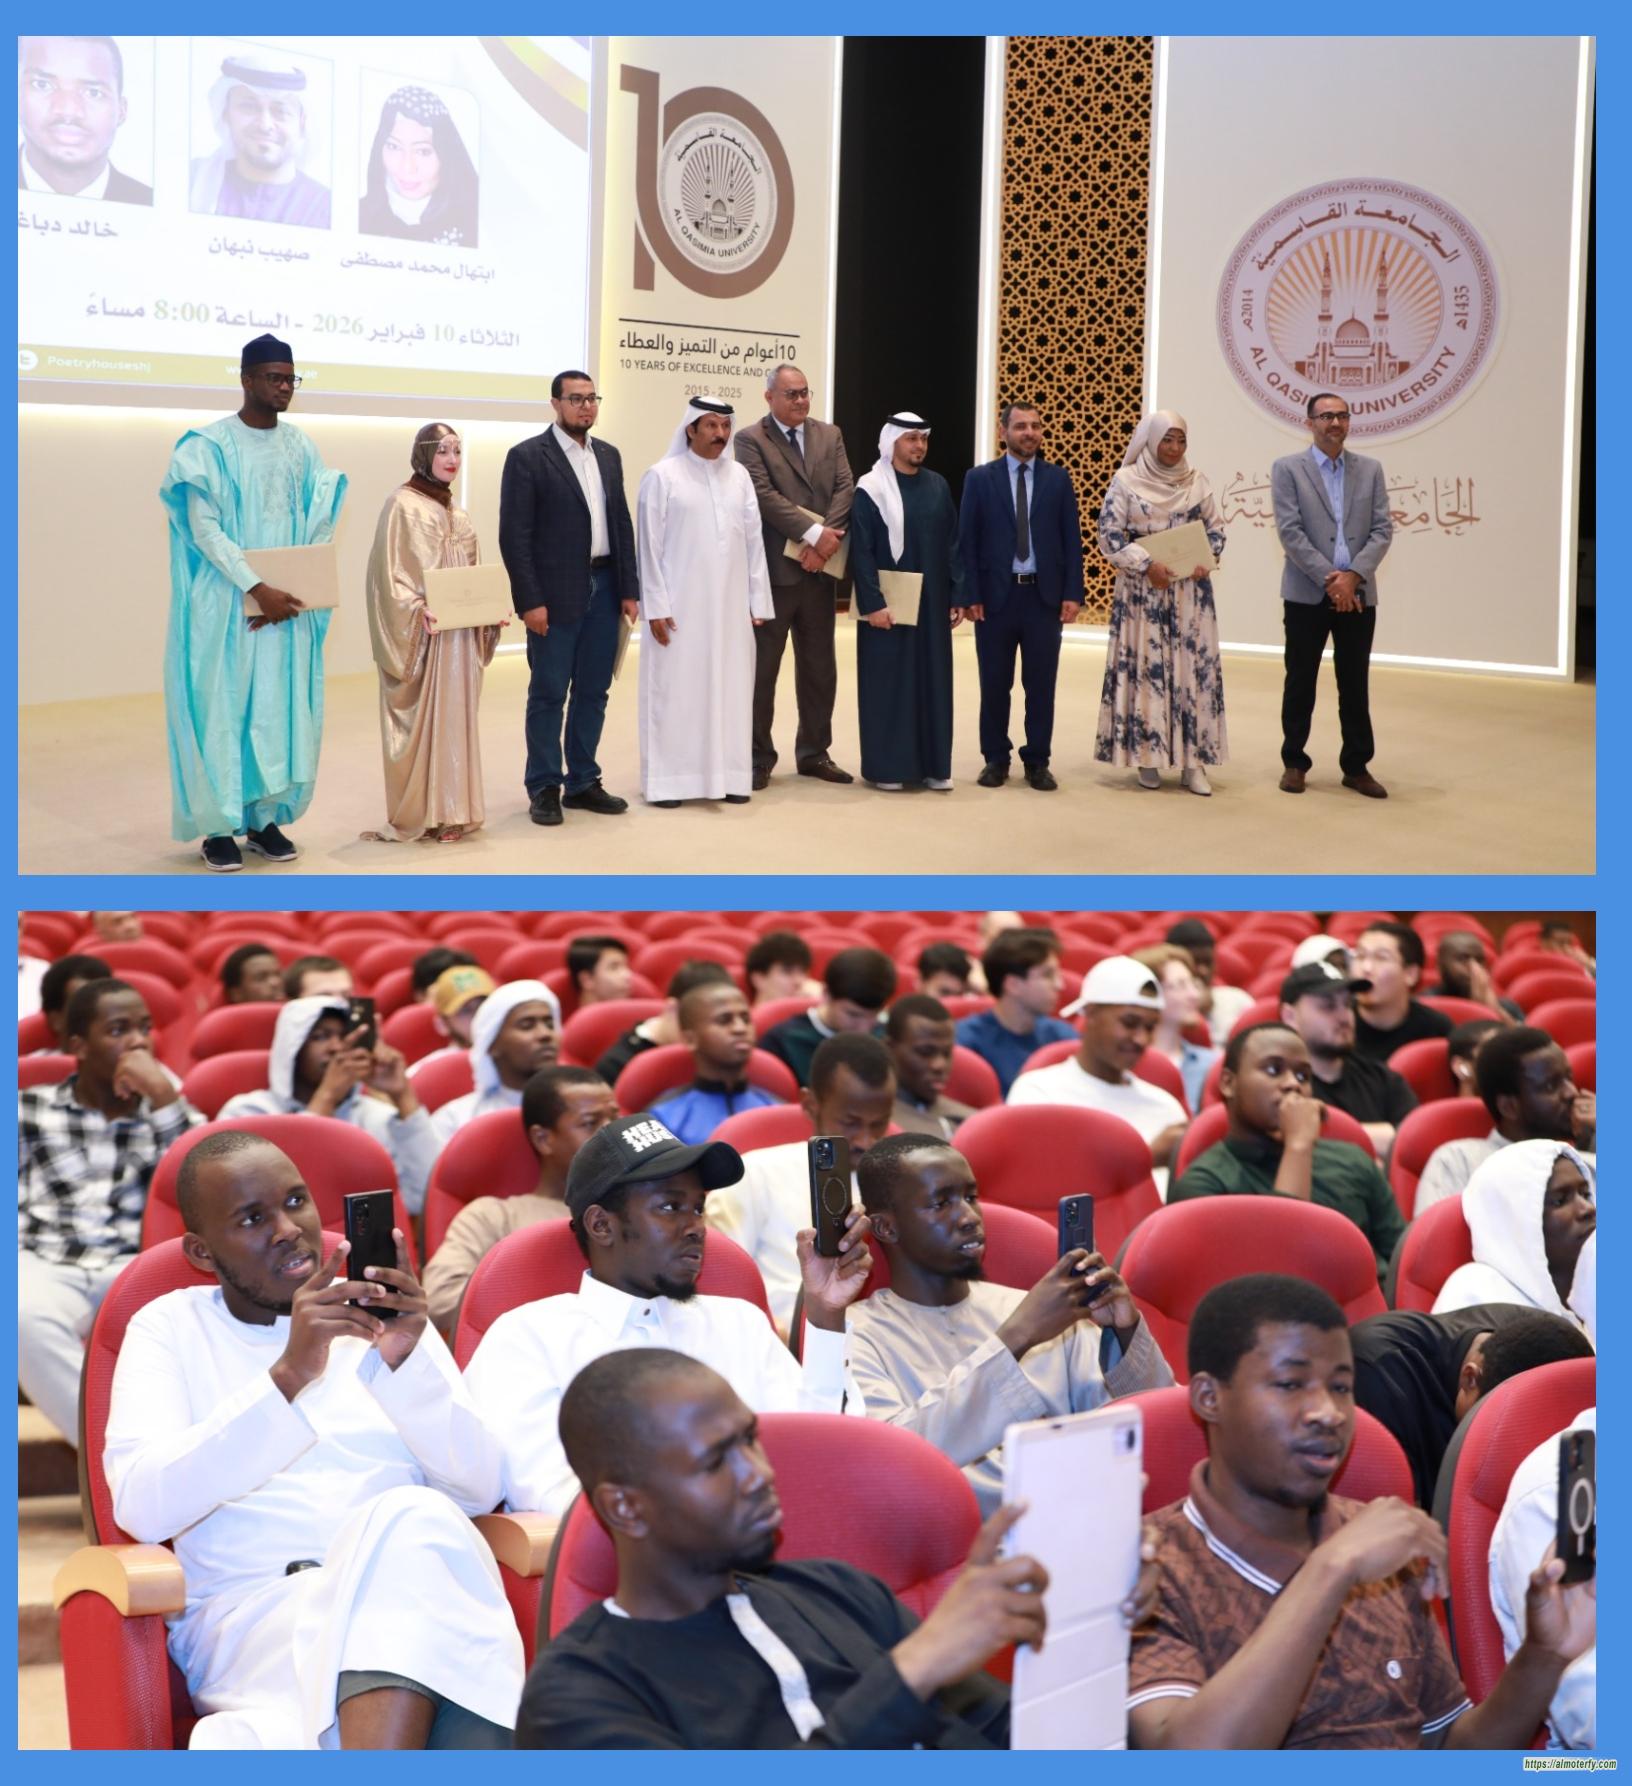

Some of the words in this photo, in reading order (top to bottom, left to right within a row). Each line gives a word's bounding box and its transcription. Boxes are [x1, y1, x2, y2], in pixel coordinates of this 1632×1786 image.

[18, 211, 62, 236] دباغ
[68, 219, 119, 238] خالد
[673, 207, 683, 224] AL
[681, 225, 716, 257] QASIMIA
[717, 222, 761, 257] UNIVERSITY
[1354, 199, 1461, 264] الجامعة
[1250, 201, 1348, 271] القاسمية
[208, 236, 254, 259] نبهان
[257, 245, 310, 262] صهيب
[340, 251, 404, 269] مصطفى
[408, 260, 451, 275] محمد
[453, 262, 496, 284] ابتهال
[153, 298, 210, 324] 8:00
[215, 305, 289, 329] الساعة
[312, 313, 364, 336] 2026
[366, 322, 426, 347] فبراير
[433, 323, 455, 342] 10
[458, 327, 521, 347] الثلاثاء
[619, 331, 674, 355] والعطاء
[678, 337, 717, 356] التميز
[720, 343, 740, 359] من
[620, 358, 632, 369] 10
[634, 359, 666, 372] YEARS
[667, 360, 682, 372] OF
[683, 362, 741, 376] EXCELLENCE
[743, 365, 764, 377] AND
[684, 384, 710, 397] 2015
[718, 385, 743, 398] 2025
[1250, 344, 1266, 371] AL
[1266, 371, 1309, 408] QASI
[1350, 345, 1456, 416] UNIVERSITY
